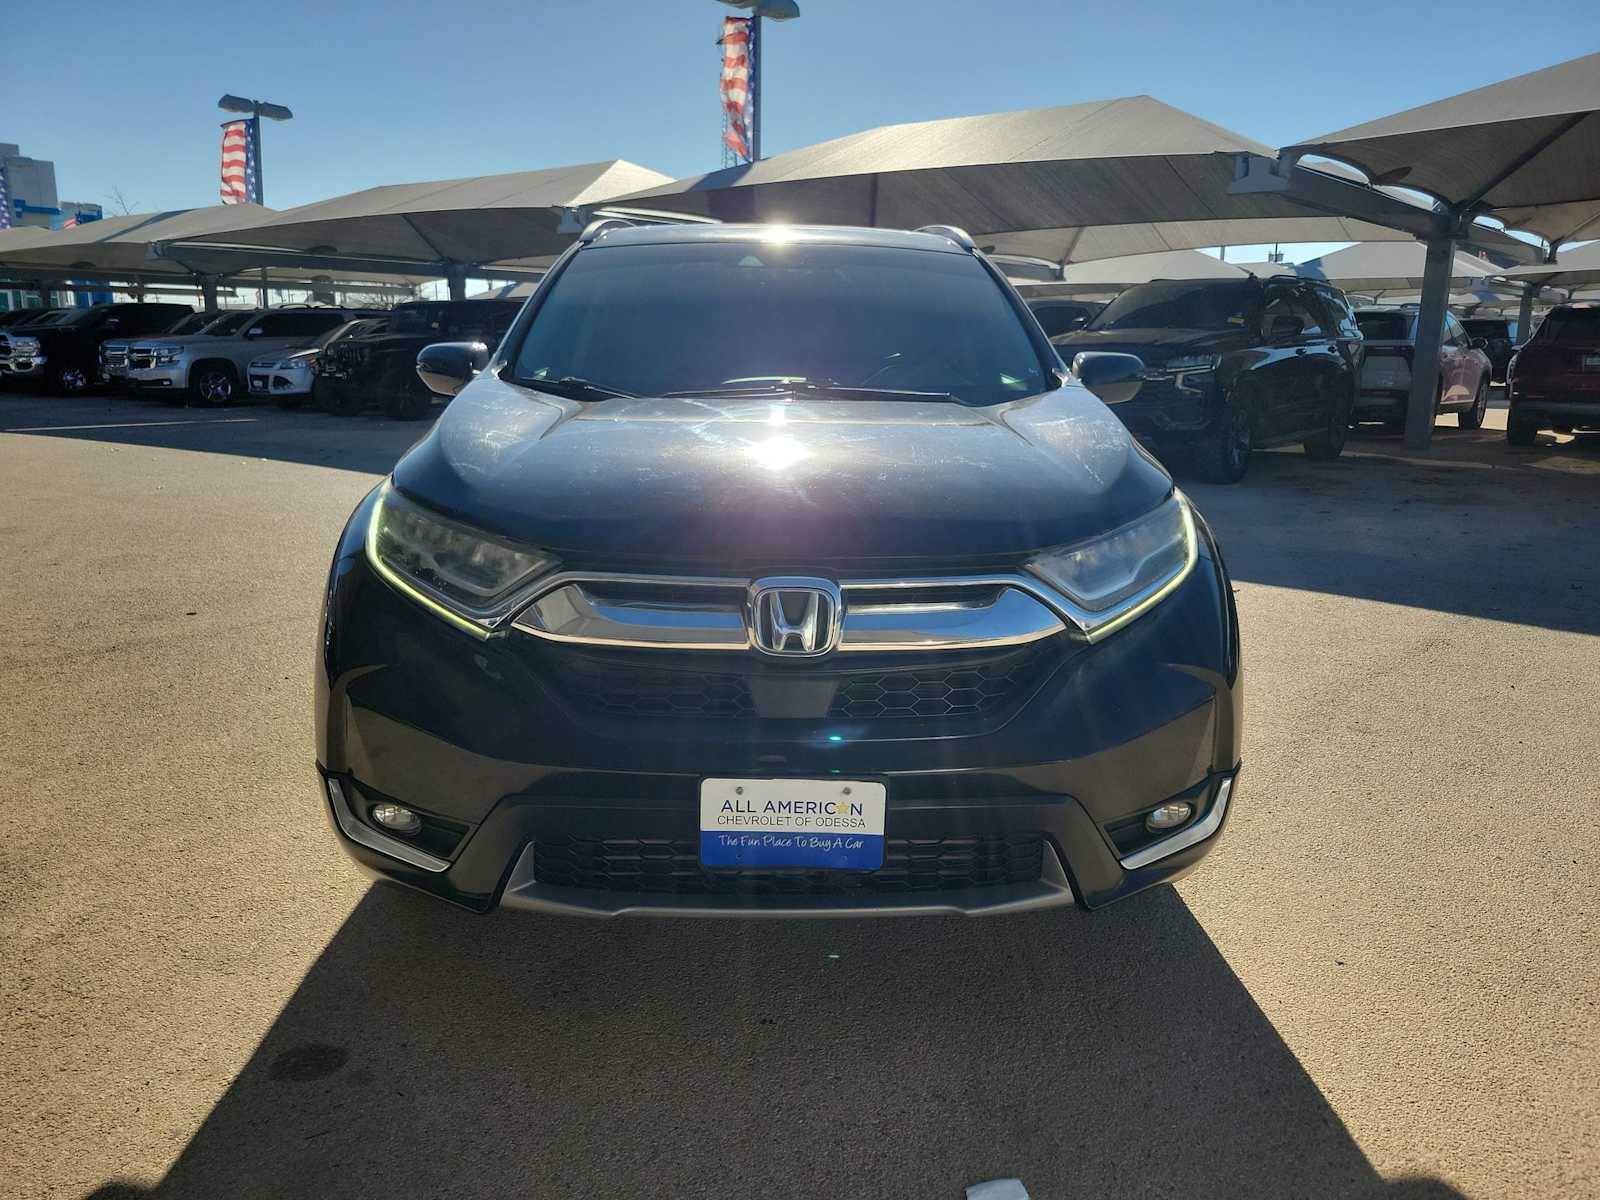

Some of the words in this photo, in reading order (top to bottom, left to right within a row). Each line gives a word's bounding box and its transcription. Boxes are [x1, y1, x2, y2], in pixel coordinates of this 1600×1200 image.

[721, 799, 757, 813] ALL
[763, 800, 863, 816] AMERICN
[717, 815, 792, 826] CHEVROLET
[795, 816, 812, 826] OF
[815, 817, 866, 828] ODESSA
[718, 834, 738, 847] The
[740, 835, 760, 846] Fun
[762, 835, 792, 848] Place
[794, 836, 807, 848] To
[809, 837, 832, 851] Buy
[832, 837, 843, 849] A
[845, 837, 865, 849] Car
